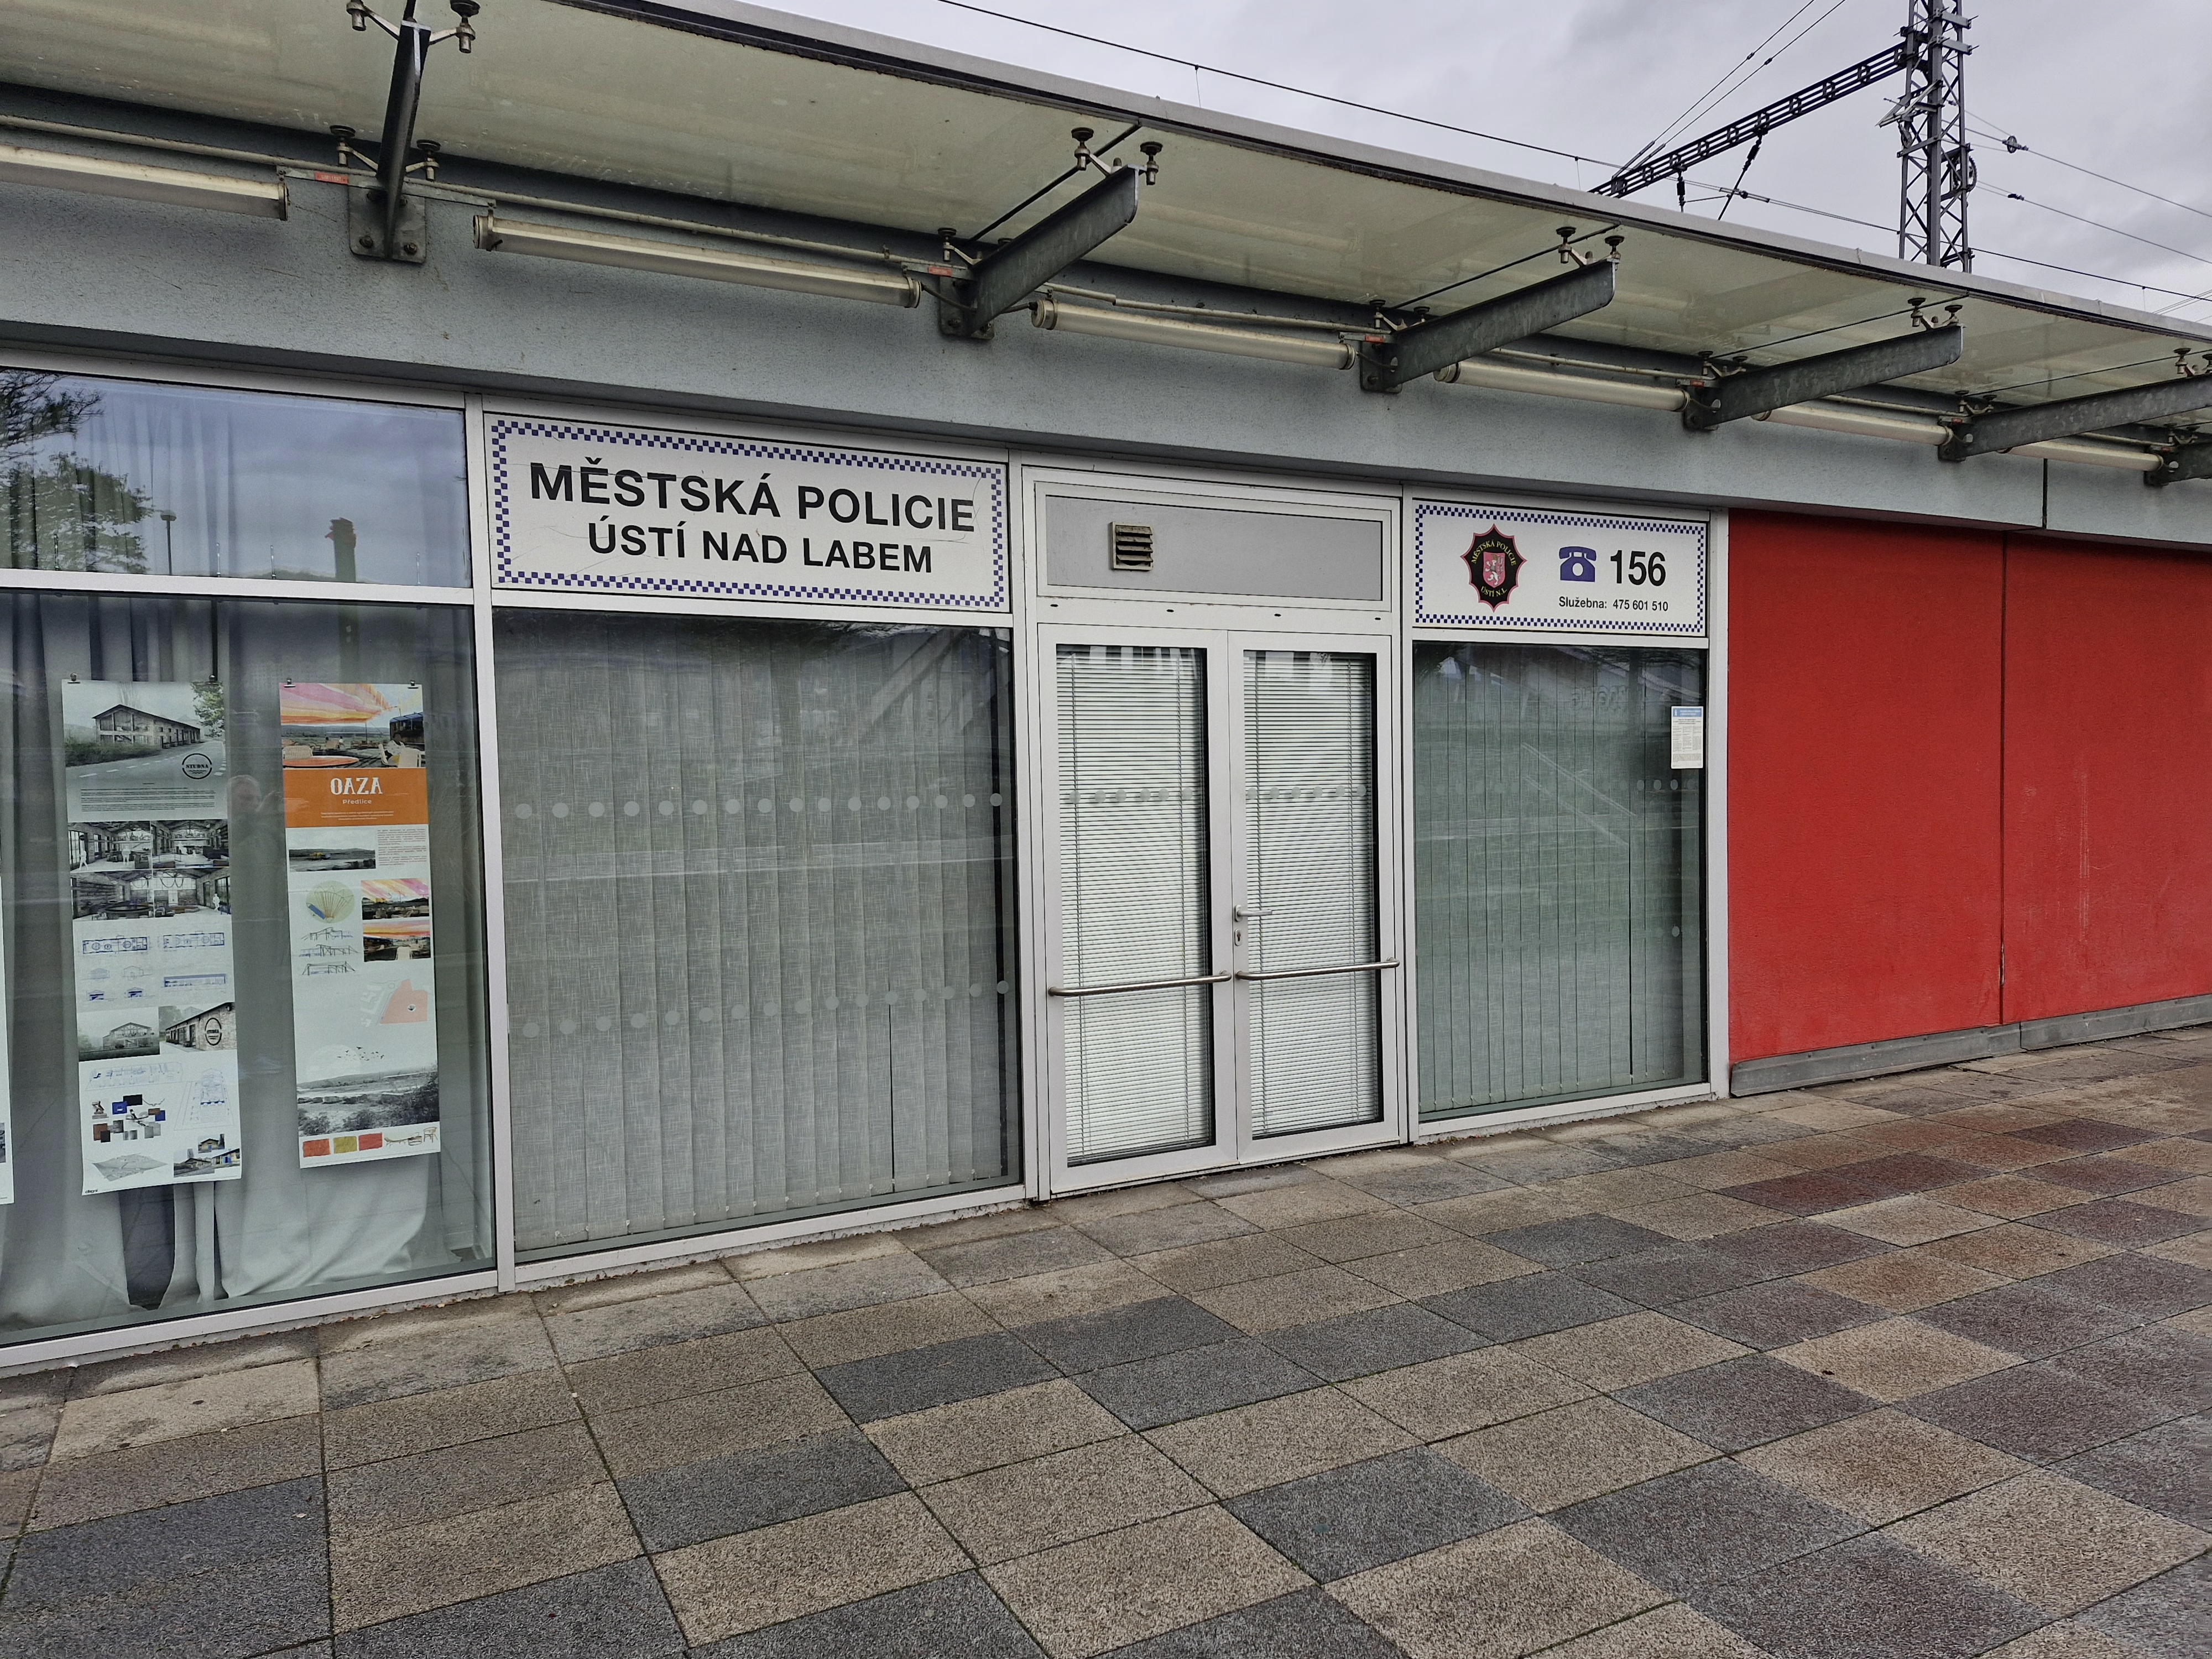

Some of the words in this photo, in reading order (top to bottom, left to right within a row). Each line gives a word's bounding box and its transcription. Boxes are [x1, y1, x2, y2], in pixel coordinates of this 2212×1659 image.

[530, 456, 781, 518] MĚSTSKÁ
[798, 485, 975, 533] POLICIE
[588, 515, 686, 559] ÚSTÍ
[703, 530, 787, 564] NAD
[803, 538, 932, 573] LABEM
[1472, 539, 1495, 564] MĚSTSKÁ
[1496, 541, 1516, 566] POLICIE
[1610, 549, 1667, 587] 156
[1480, 586, 1495, 597] ÚSTÍ
[1558, 596, 1607, 609] Služebna:
[1613, 599, 1630, 610] 475
[1632, 599, 1648, 611] 601
[1651, 601, 1669, 612] 510
[330, 776, 383, 795] OAZA
